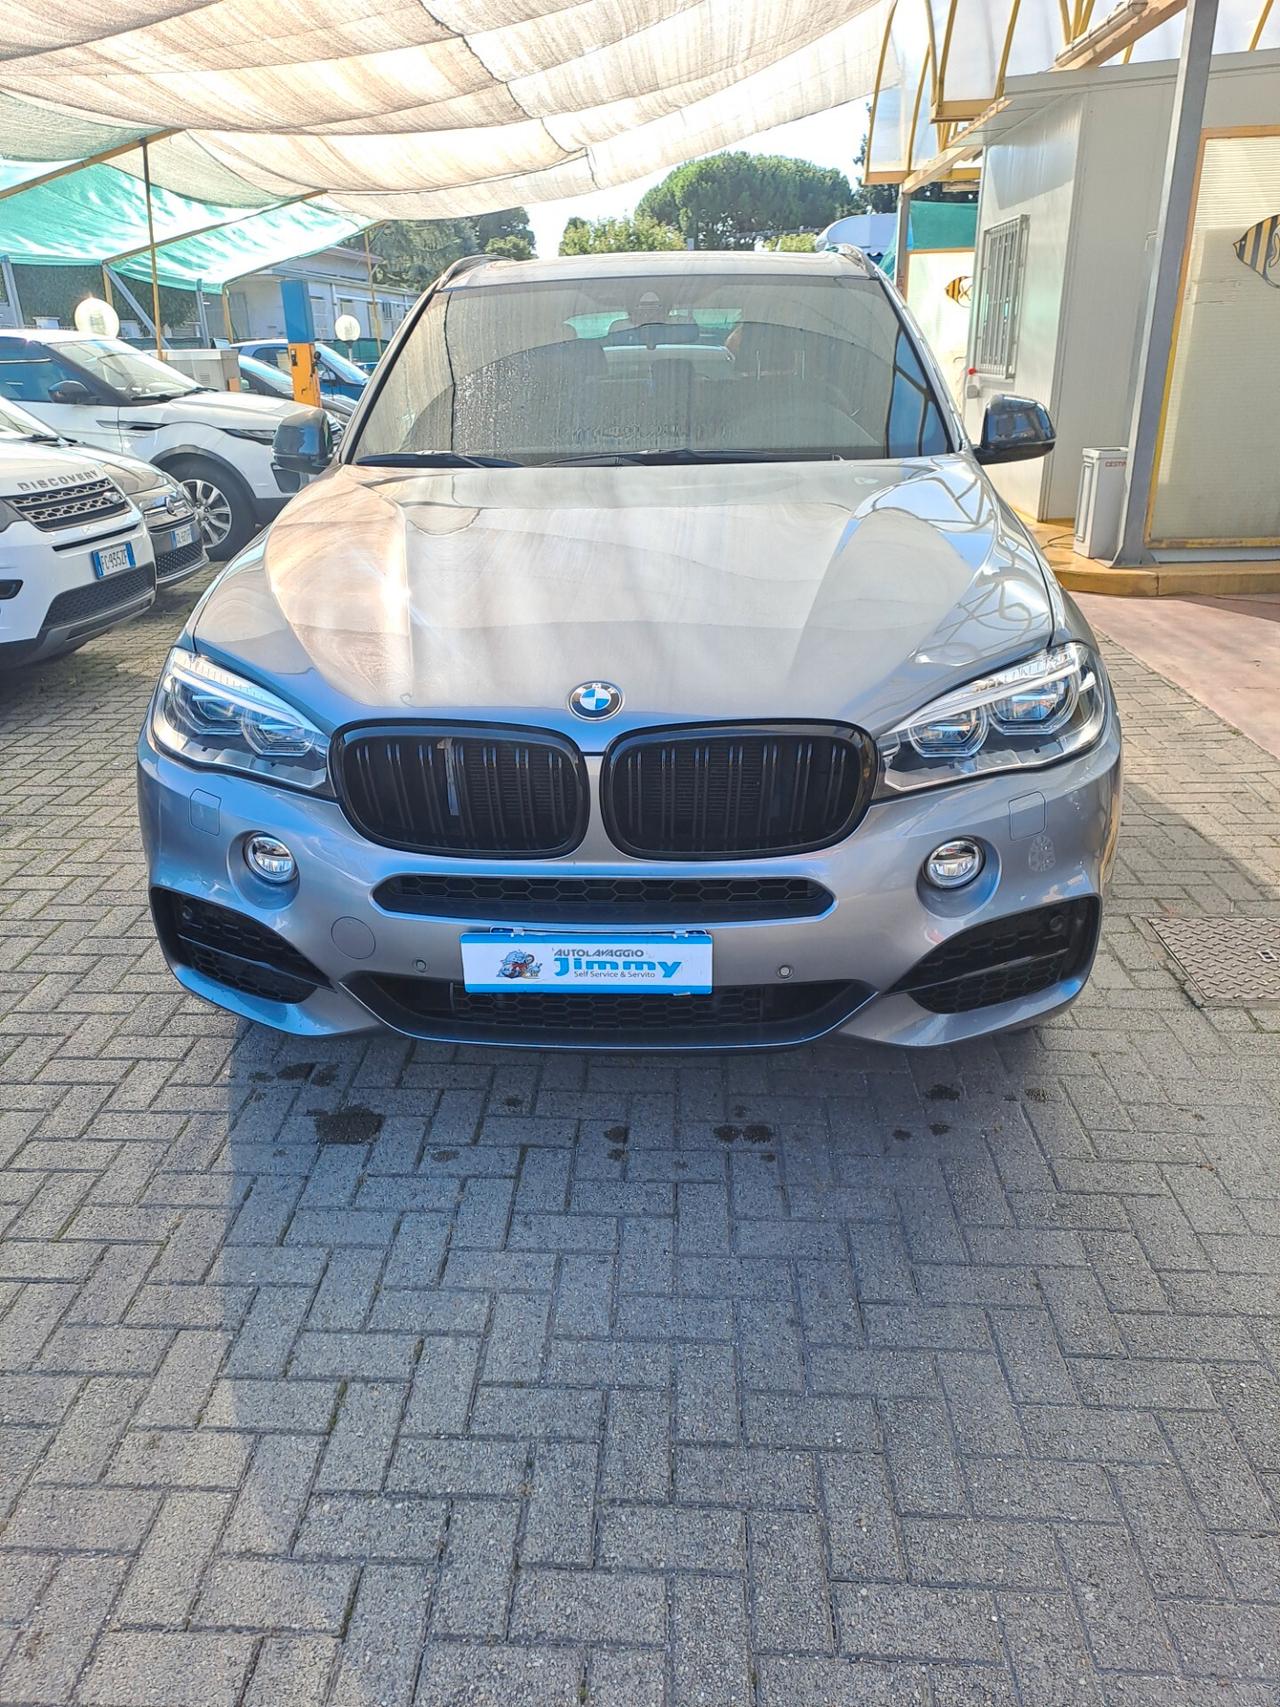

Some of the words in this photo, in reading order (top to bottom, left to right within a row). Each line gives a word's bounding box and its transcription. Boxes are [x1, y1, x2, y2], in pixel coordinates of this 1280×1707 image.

[17, 469, 99, 491] DISCOVERY
[553, 948, 644, 957] AUTOLAVAGGIO
[554, 957, 682, 978] Jimmy
[574, 970, 588, 978] Self
[590, 970, 618, 978] Service
[628, 970, 655, 978] Servito
